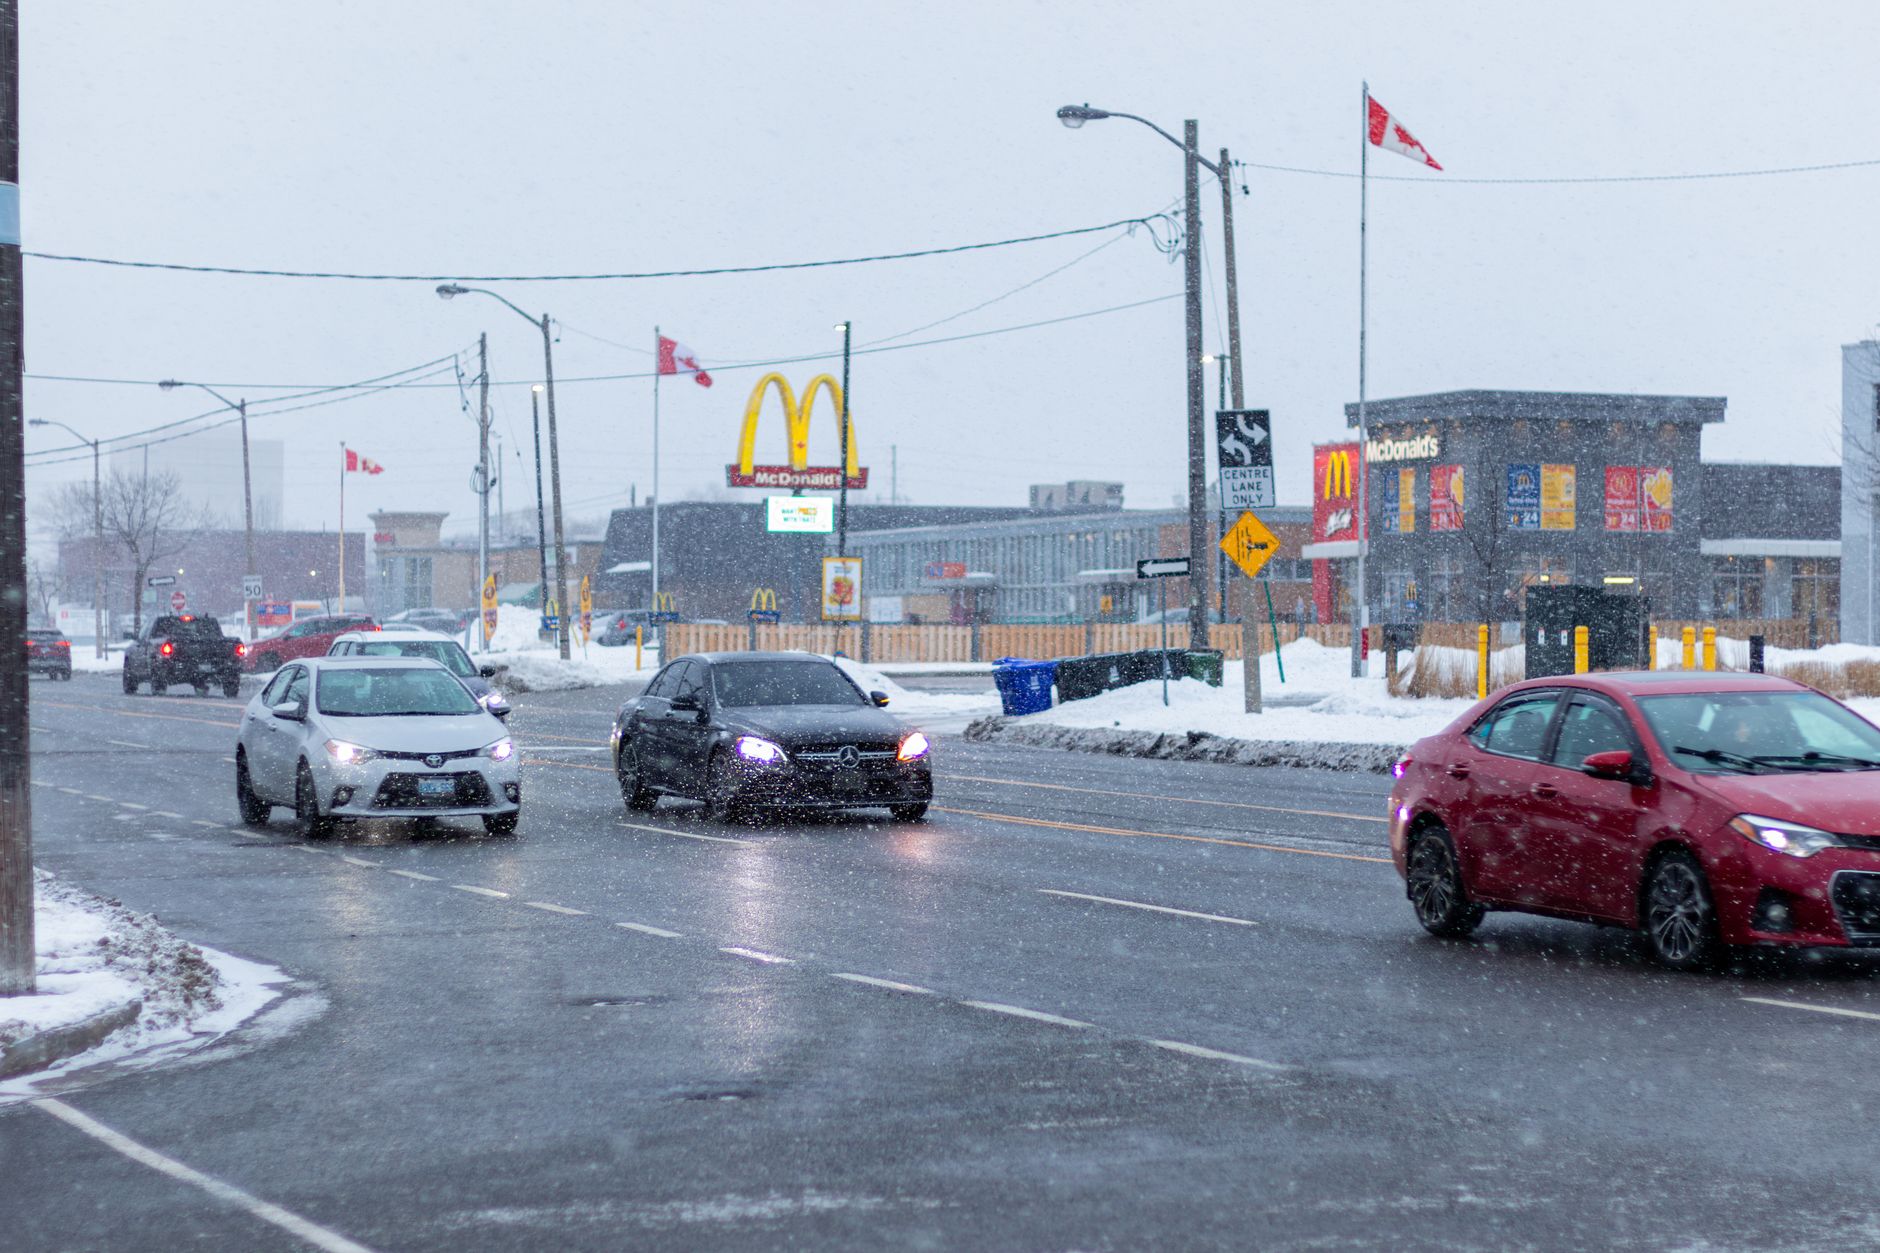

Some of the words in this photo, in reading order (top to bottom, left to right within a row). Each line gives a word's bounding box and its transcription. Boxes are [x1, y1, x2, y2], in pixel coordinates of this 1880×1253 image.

[1366, 435, 1439, 463] McDonald's
[1223, 469, 1270, 480] CENTRE
[1231, 481, 1263, 492] LANE
[1232, 493, 1264, 505] ONLY
[245, 584, 261, 597] 50
